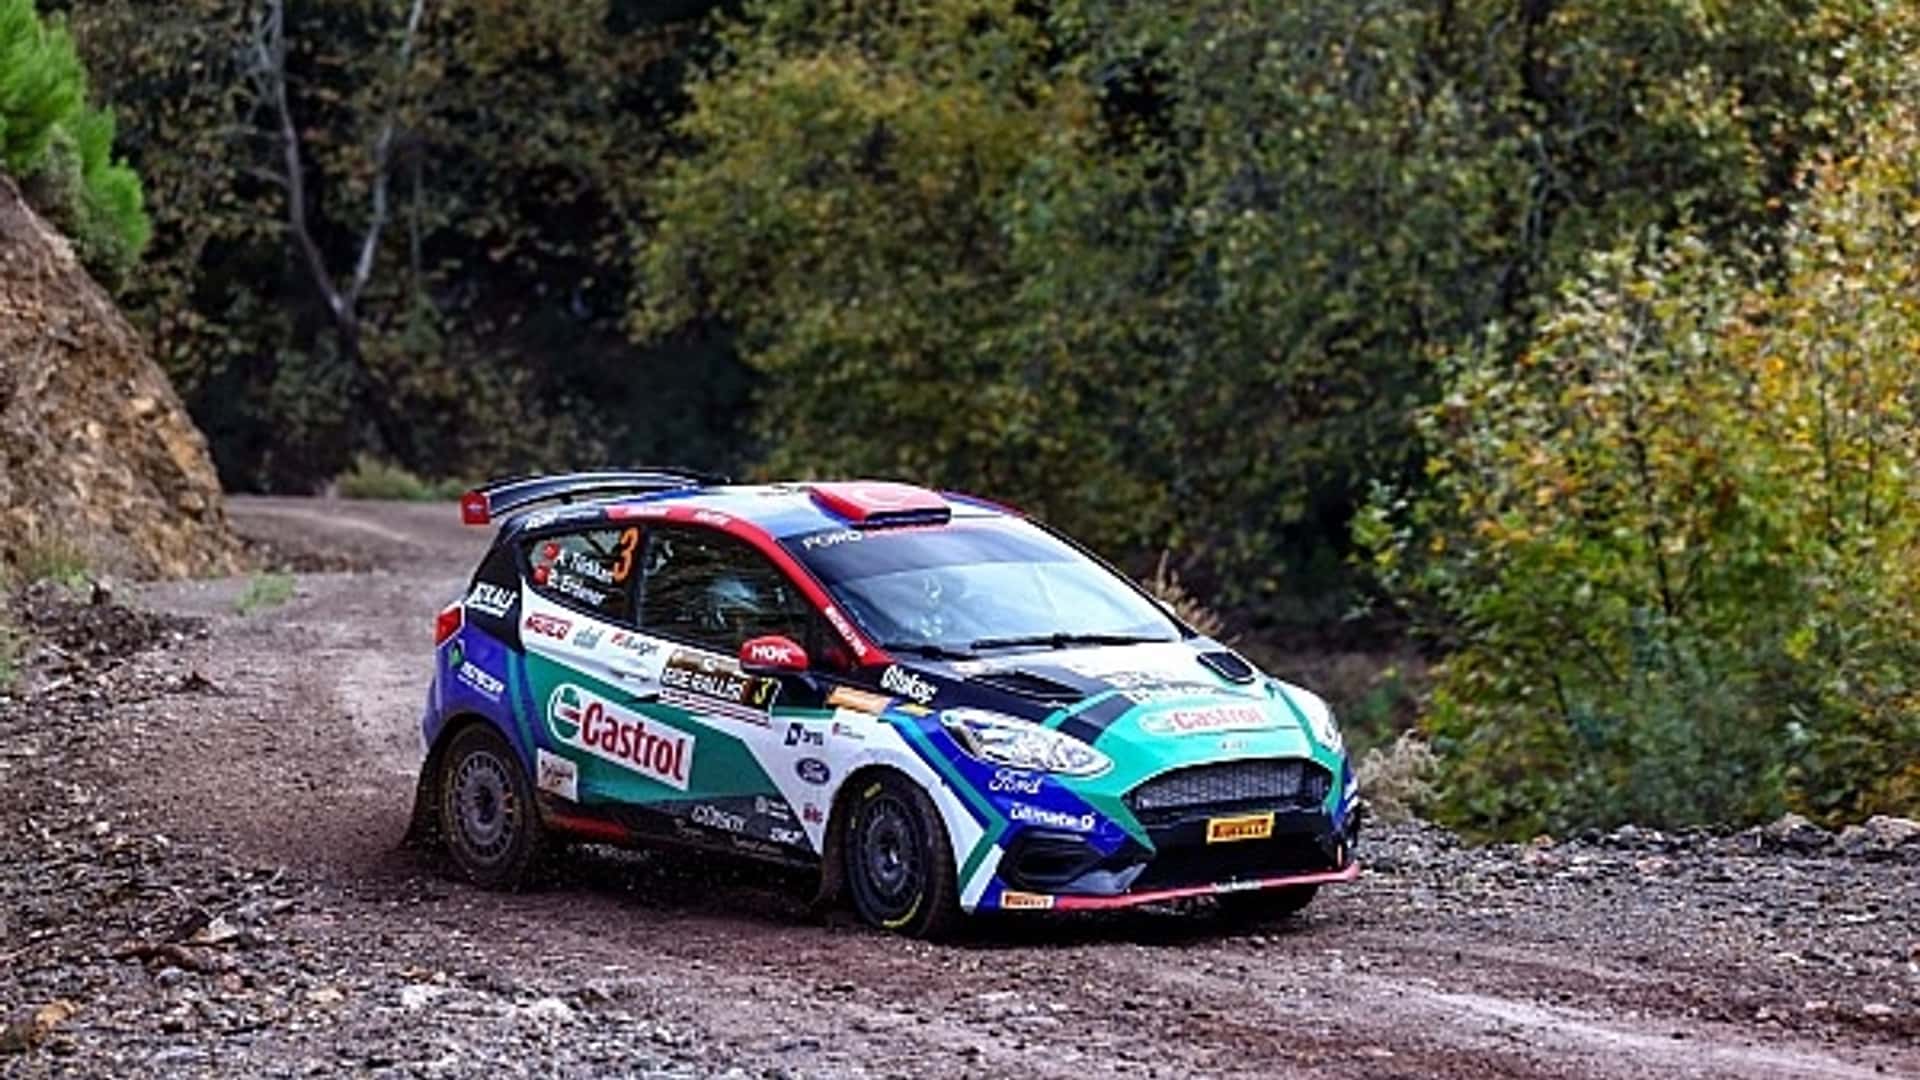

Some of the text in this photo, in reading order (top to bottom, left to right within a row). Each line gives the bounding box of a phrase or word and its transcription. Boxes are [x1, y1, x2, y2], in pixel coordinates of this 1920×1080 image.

[803, 530, 863, 550] FORD
[614, 527, 639, 581] 3
[755, 677, 775, 704] 3
[1173, 707, 1263, 729] Castrol
[581, 702, 685, 782] Castrol
[988, 768, 1043, 794] Ford
